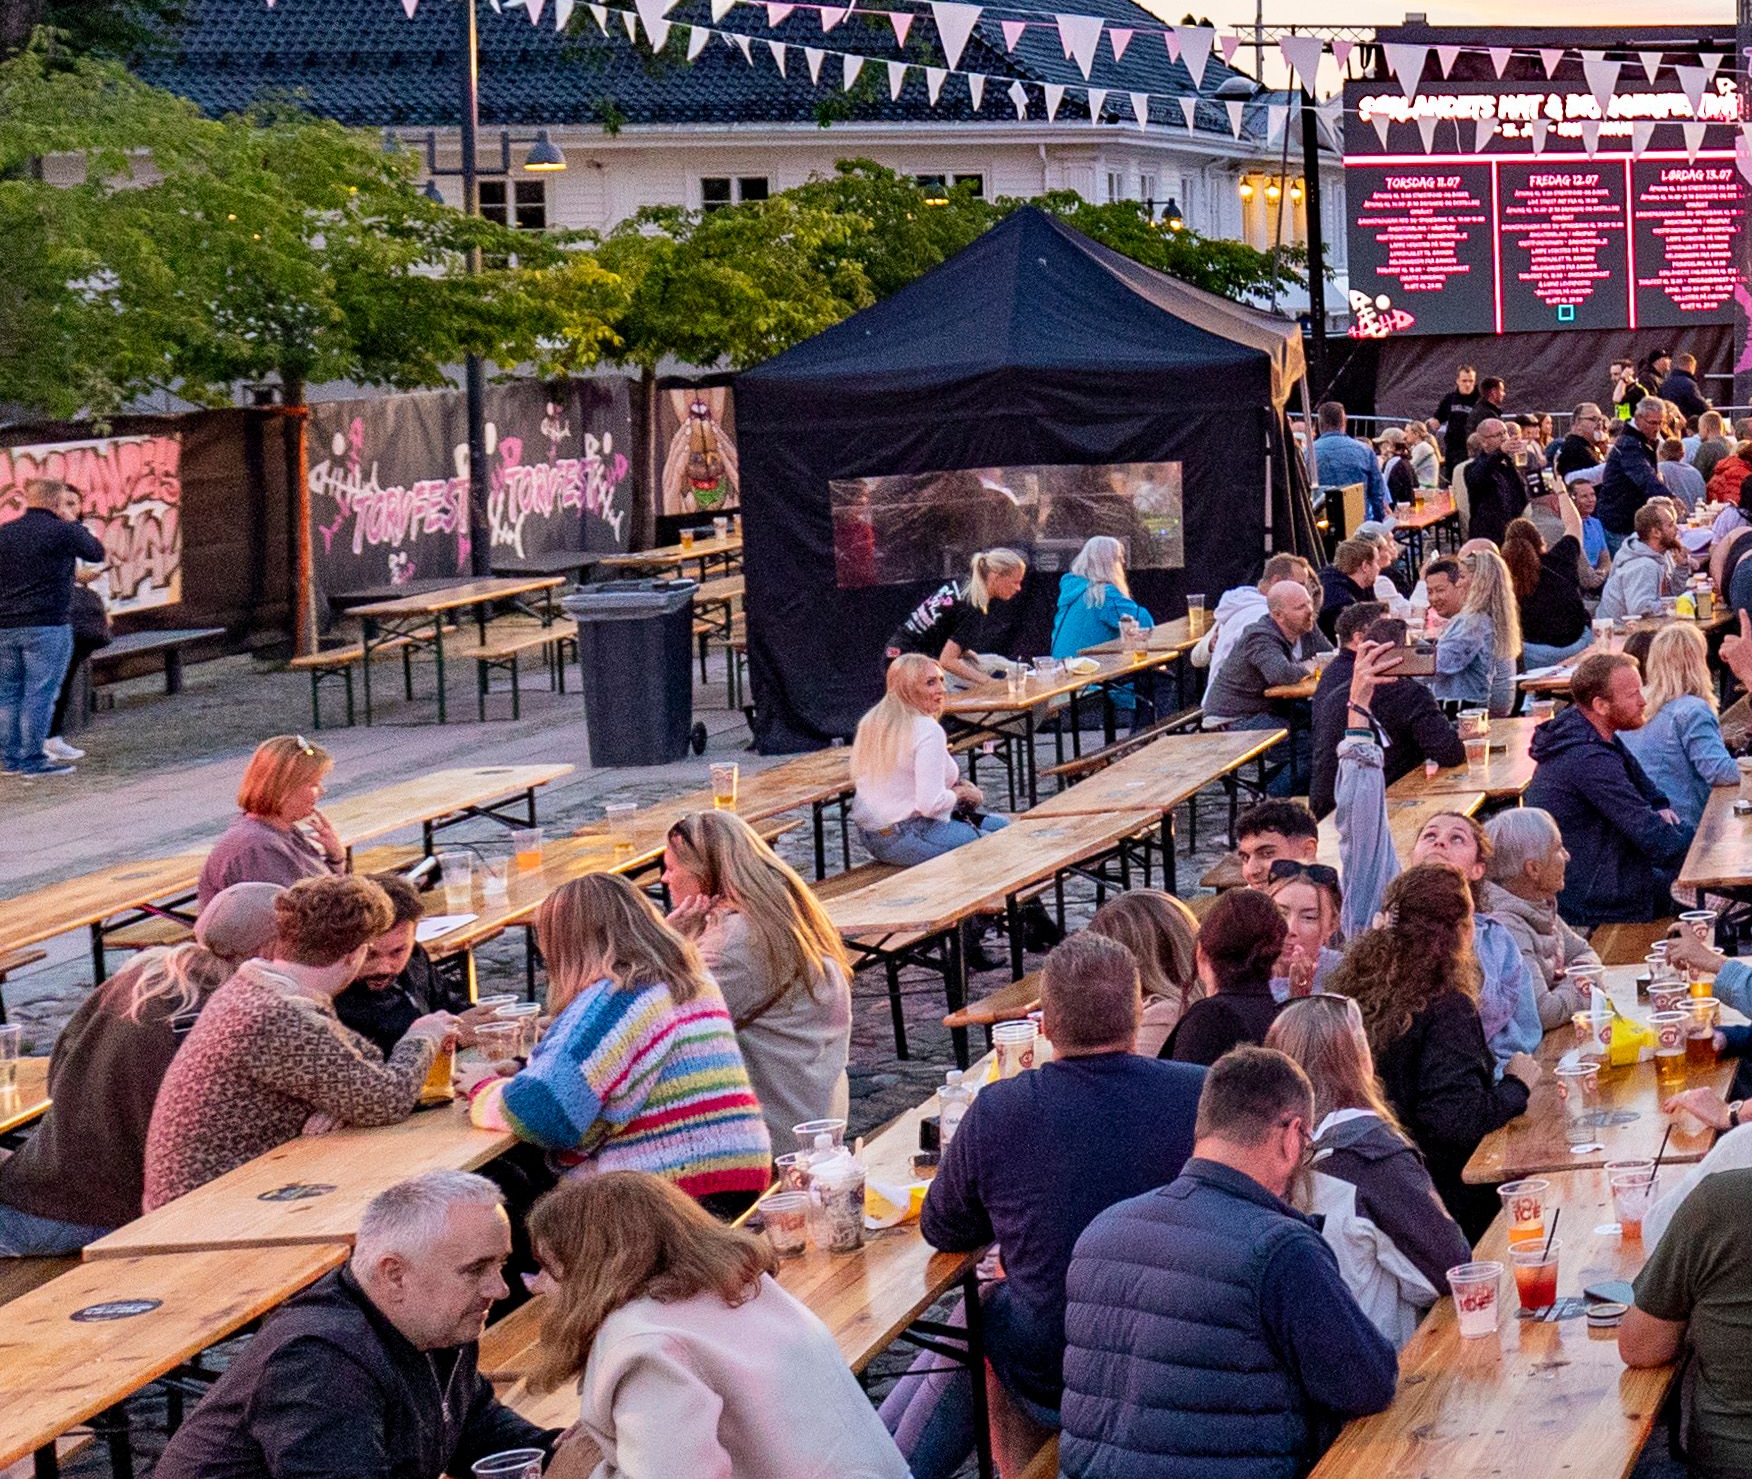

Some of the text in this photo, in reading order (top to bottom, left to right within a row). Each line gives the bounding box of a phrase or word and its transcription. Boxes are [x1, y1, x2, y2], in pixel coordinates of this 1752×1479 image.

[1529, 174, 1599, 187] FREDAG 12.07
[1660, 169, 1733, 181] LØRDAG 13.07
[1385, 176, 1461, 189] TORSDAG 11.07
[353, 477, 471, 554] TORVFEST
